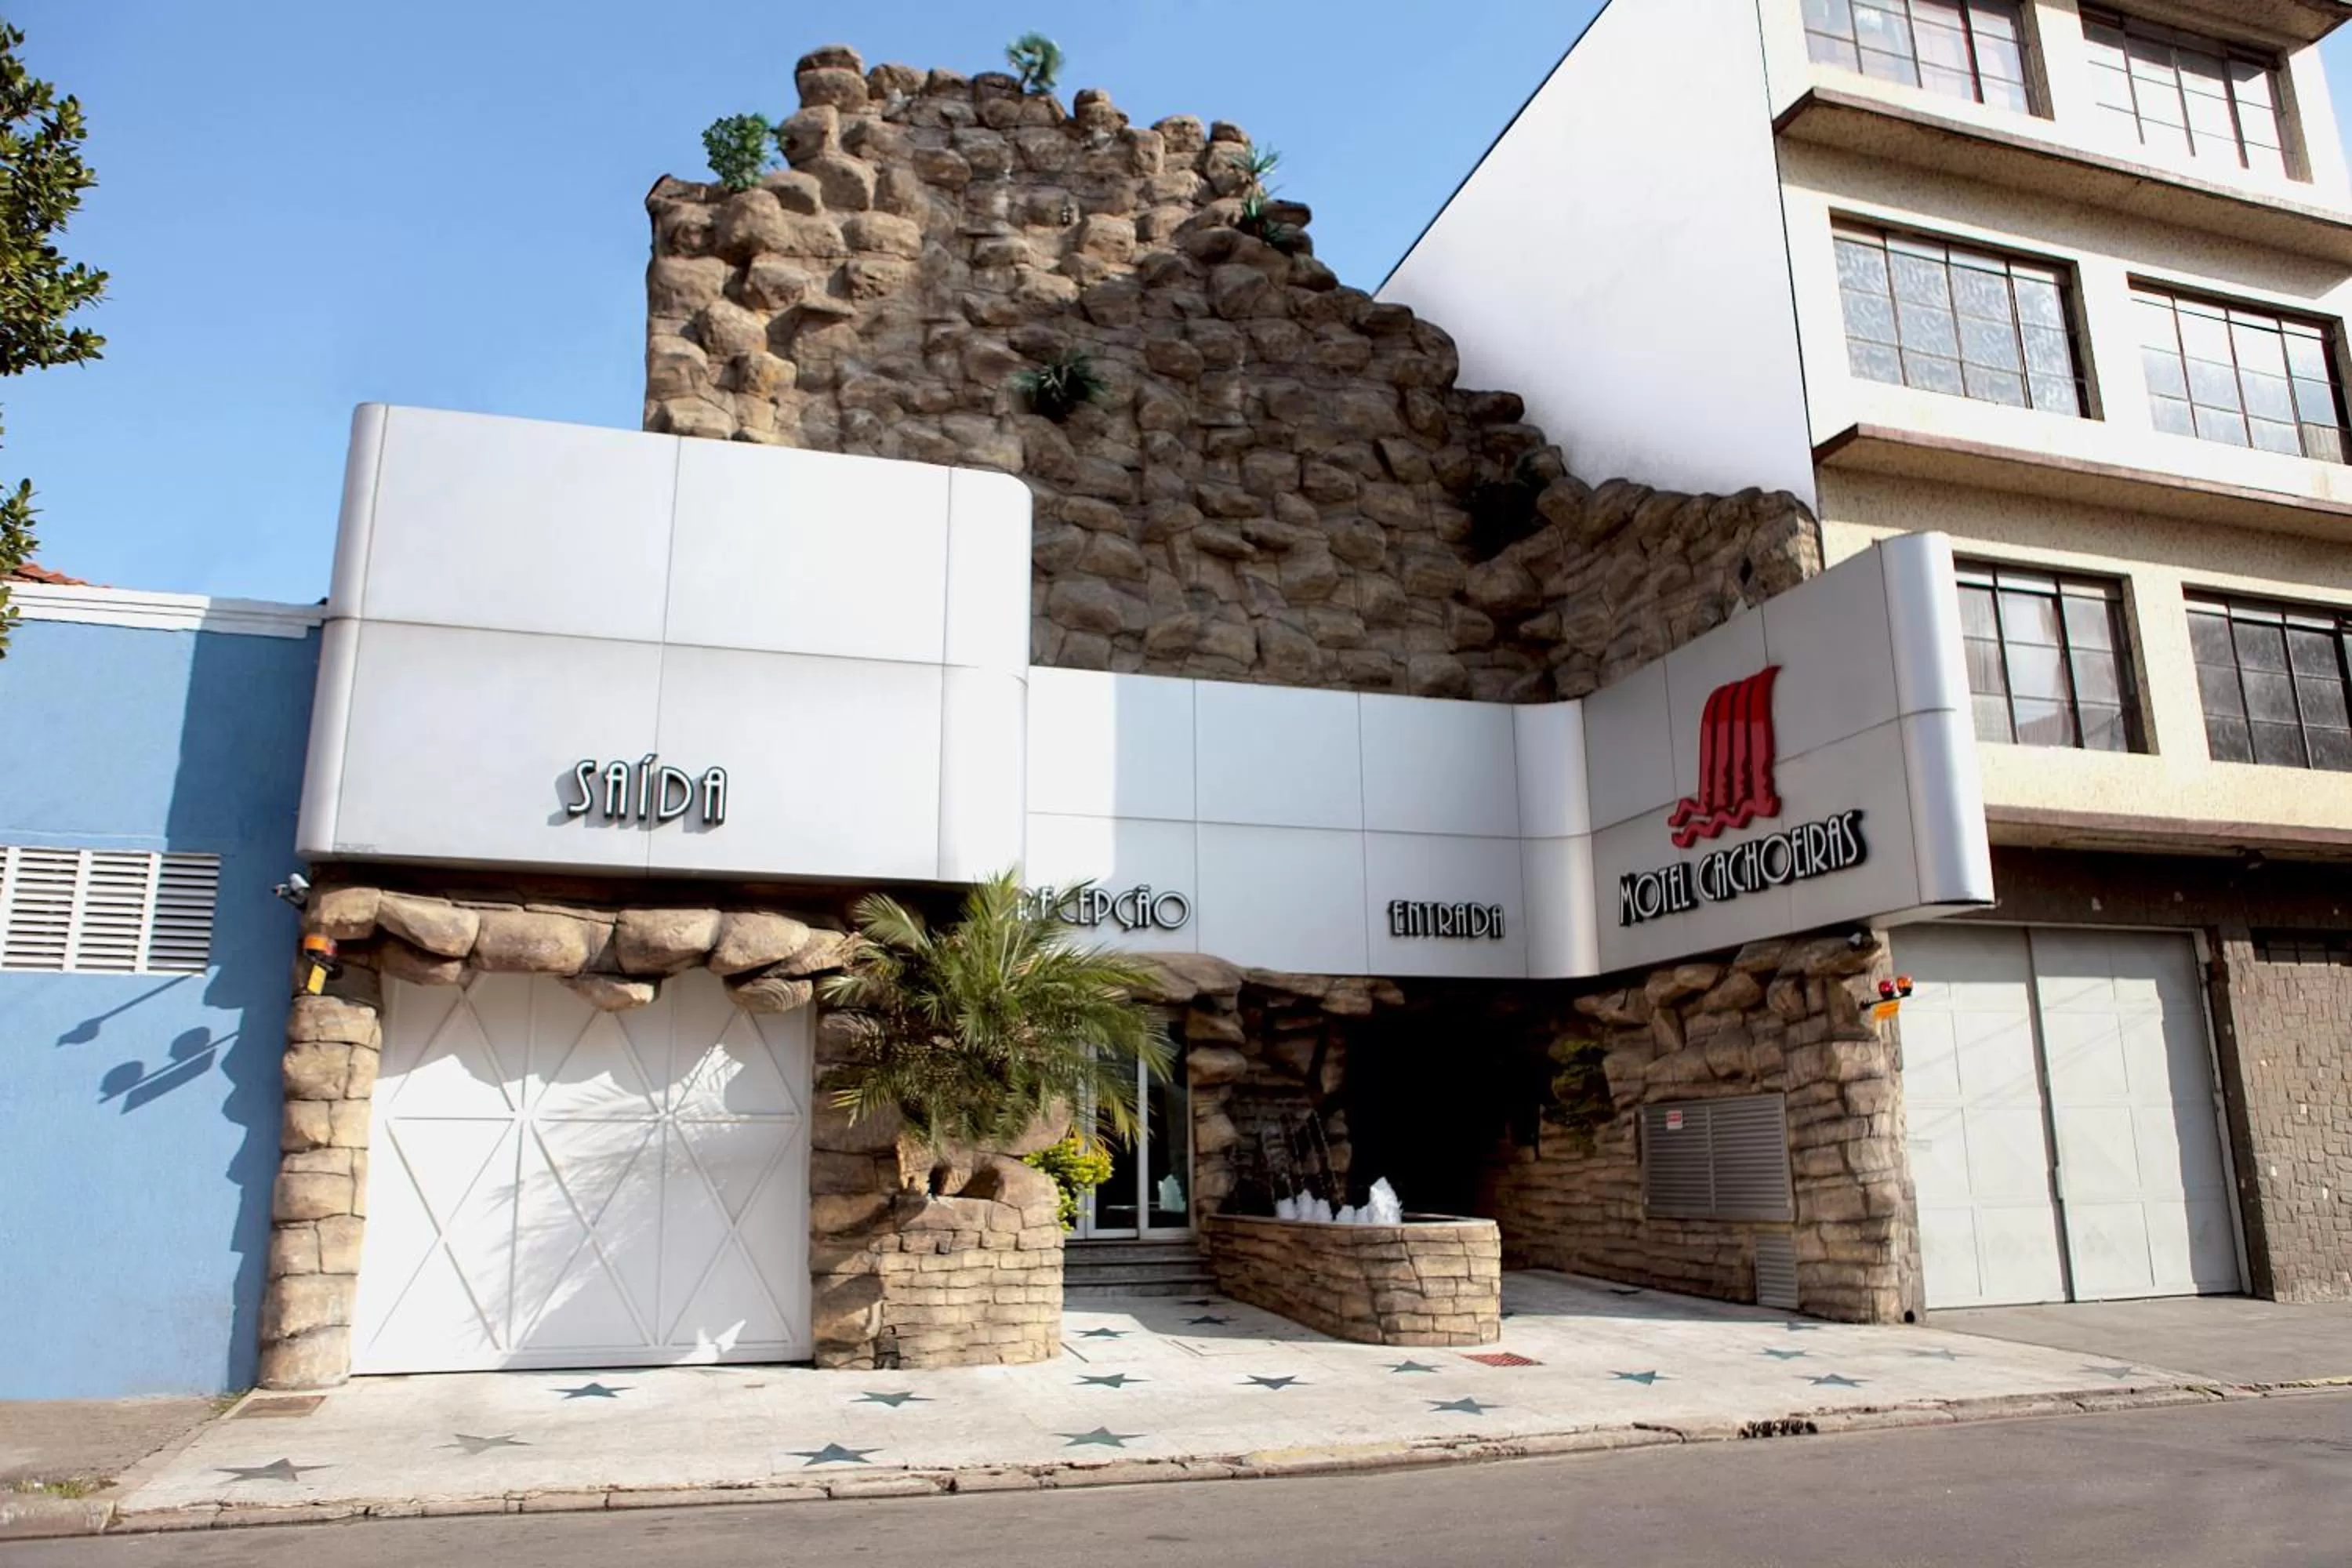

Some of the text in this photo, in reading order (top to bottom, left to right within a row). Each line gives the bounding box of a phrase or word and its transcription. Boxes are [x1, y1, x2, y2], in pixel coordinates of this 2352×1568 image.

[566, 753, 728, 825] SAÍDA
[1618, 809, 1867, 926] MOTEL CACHOEIRAS
[1388, 900, 1505, 938] ENTRADA
